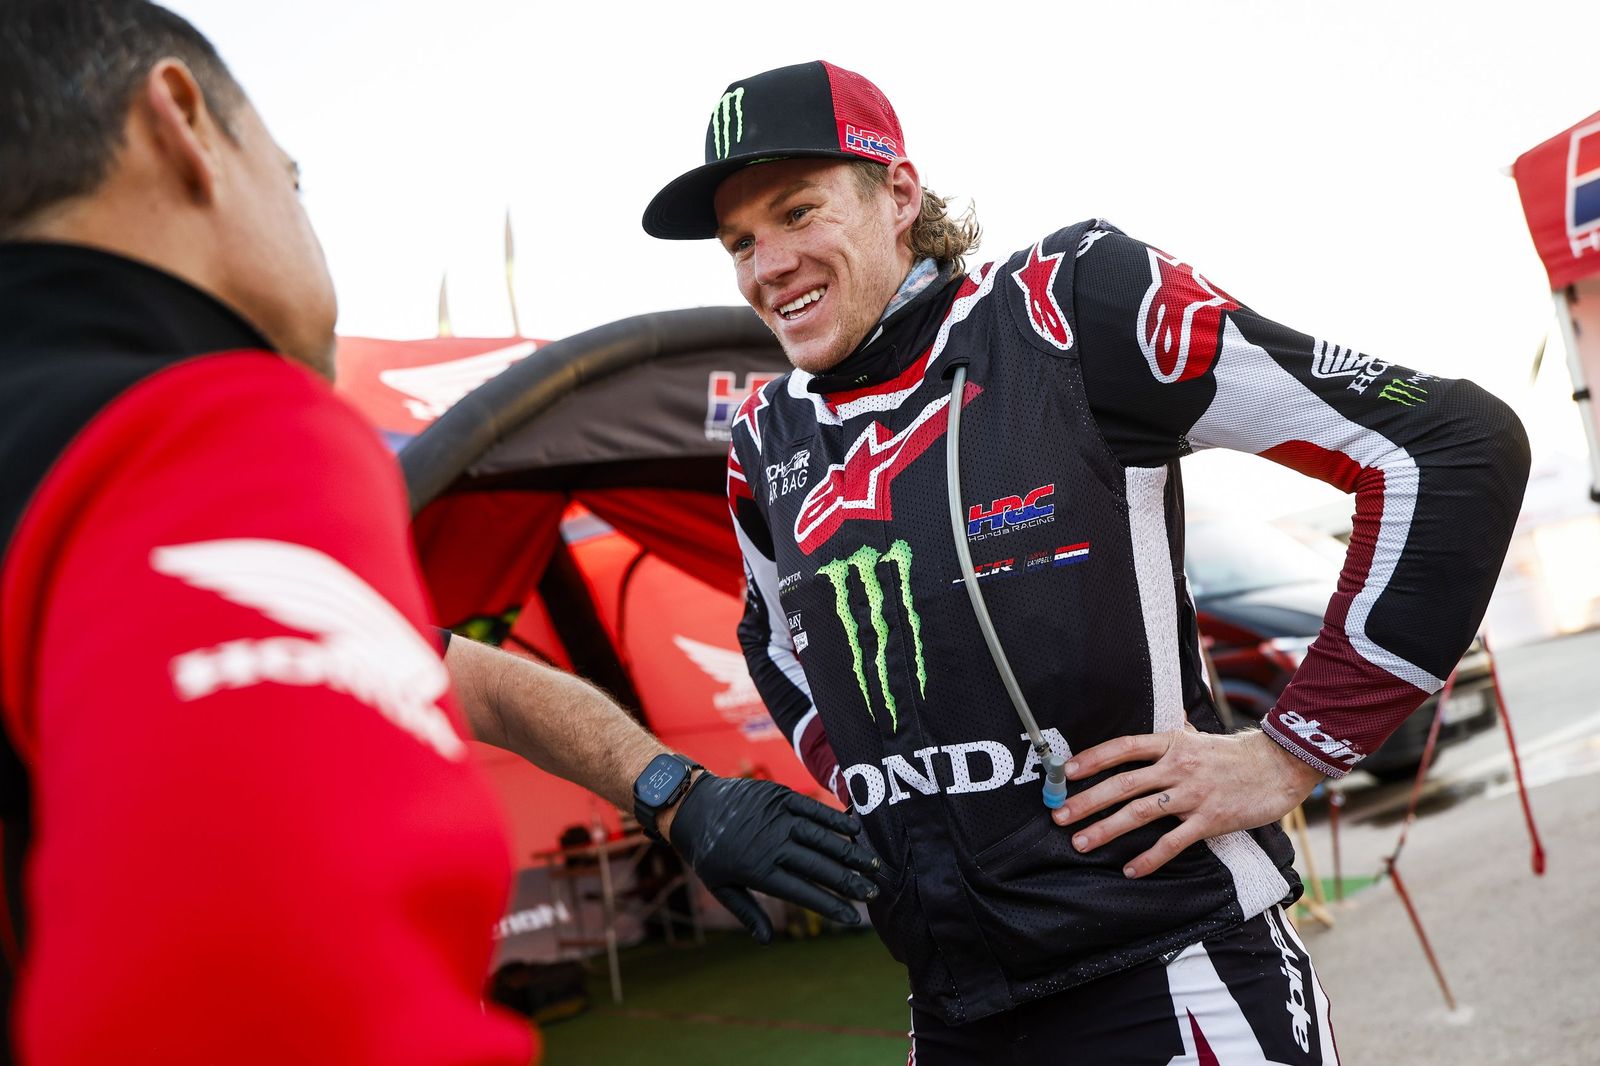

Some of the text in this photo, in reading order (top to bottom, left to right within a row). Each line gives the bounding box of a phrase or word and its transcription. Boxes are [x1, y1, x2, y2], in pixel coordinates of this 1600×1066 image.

[846, 124, 898, 157] HRC
[781, 469, 808, 495] BAG
[967, 483, 1055, 537] HRC
[968, 515, 1055, 542] Honda RACING
[1279, 710, 1366, 765] alpin
[649, 769, 672, 790] 4:57
[843, 728, 1073, 816] ONDA
